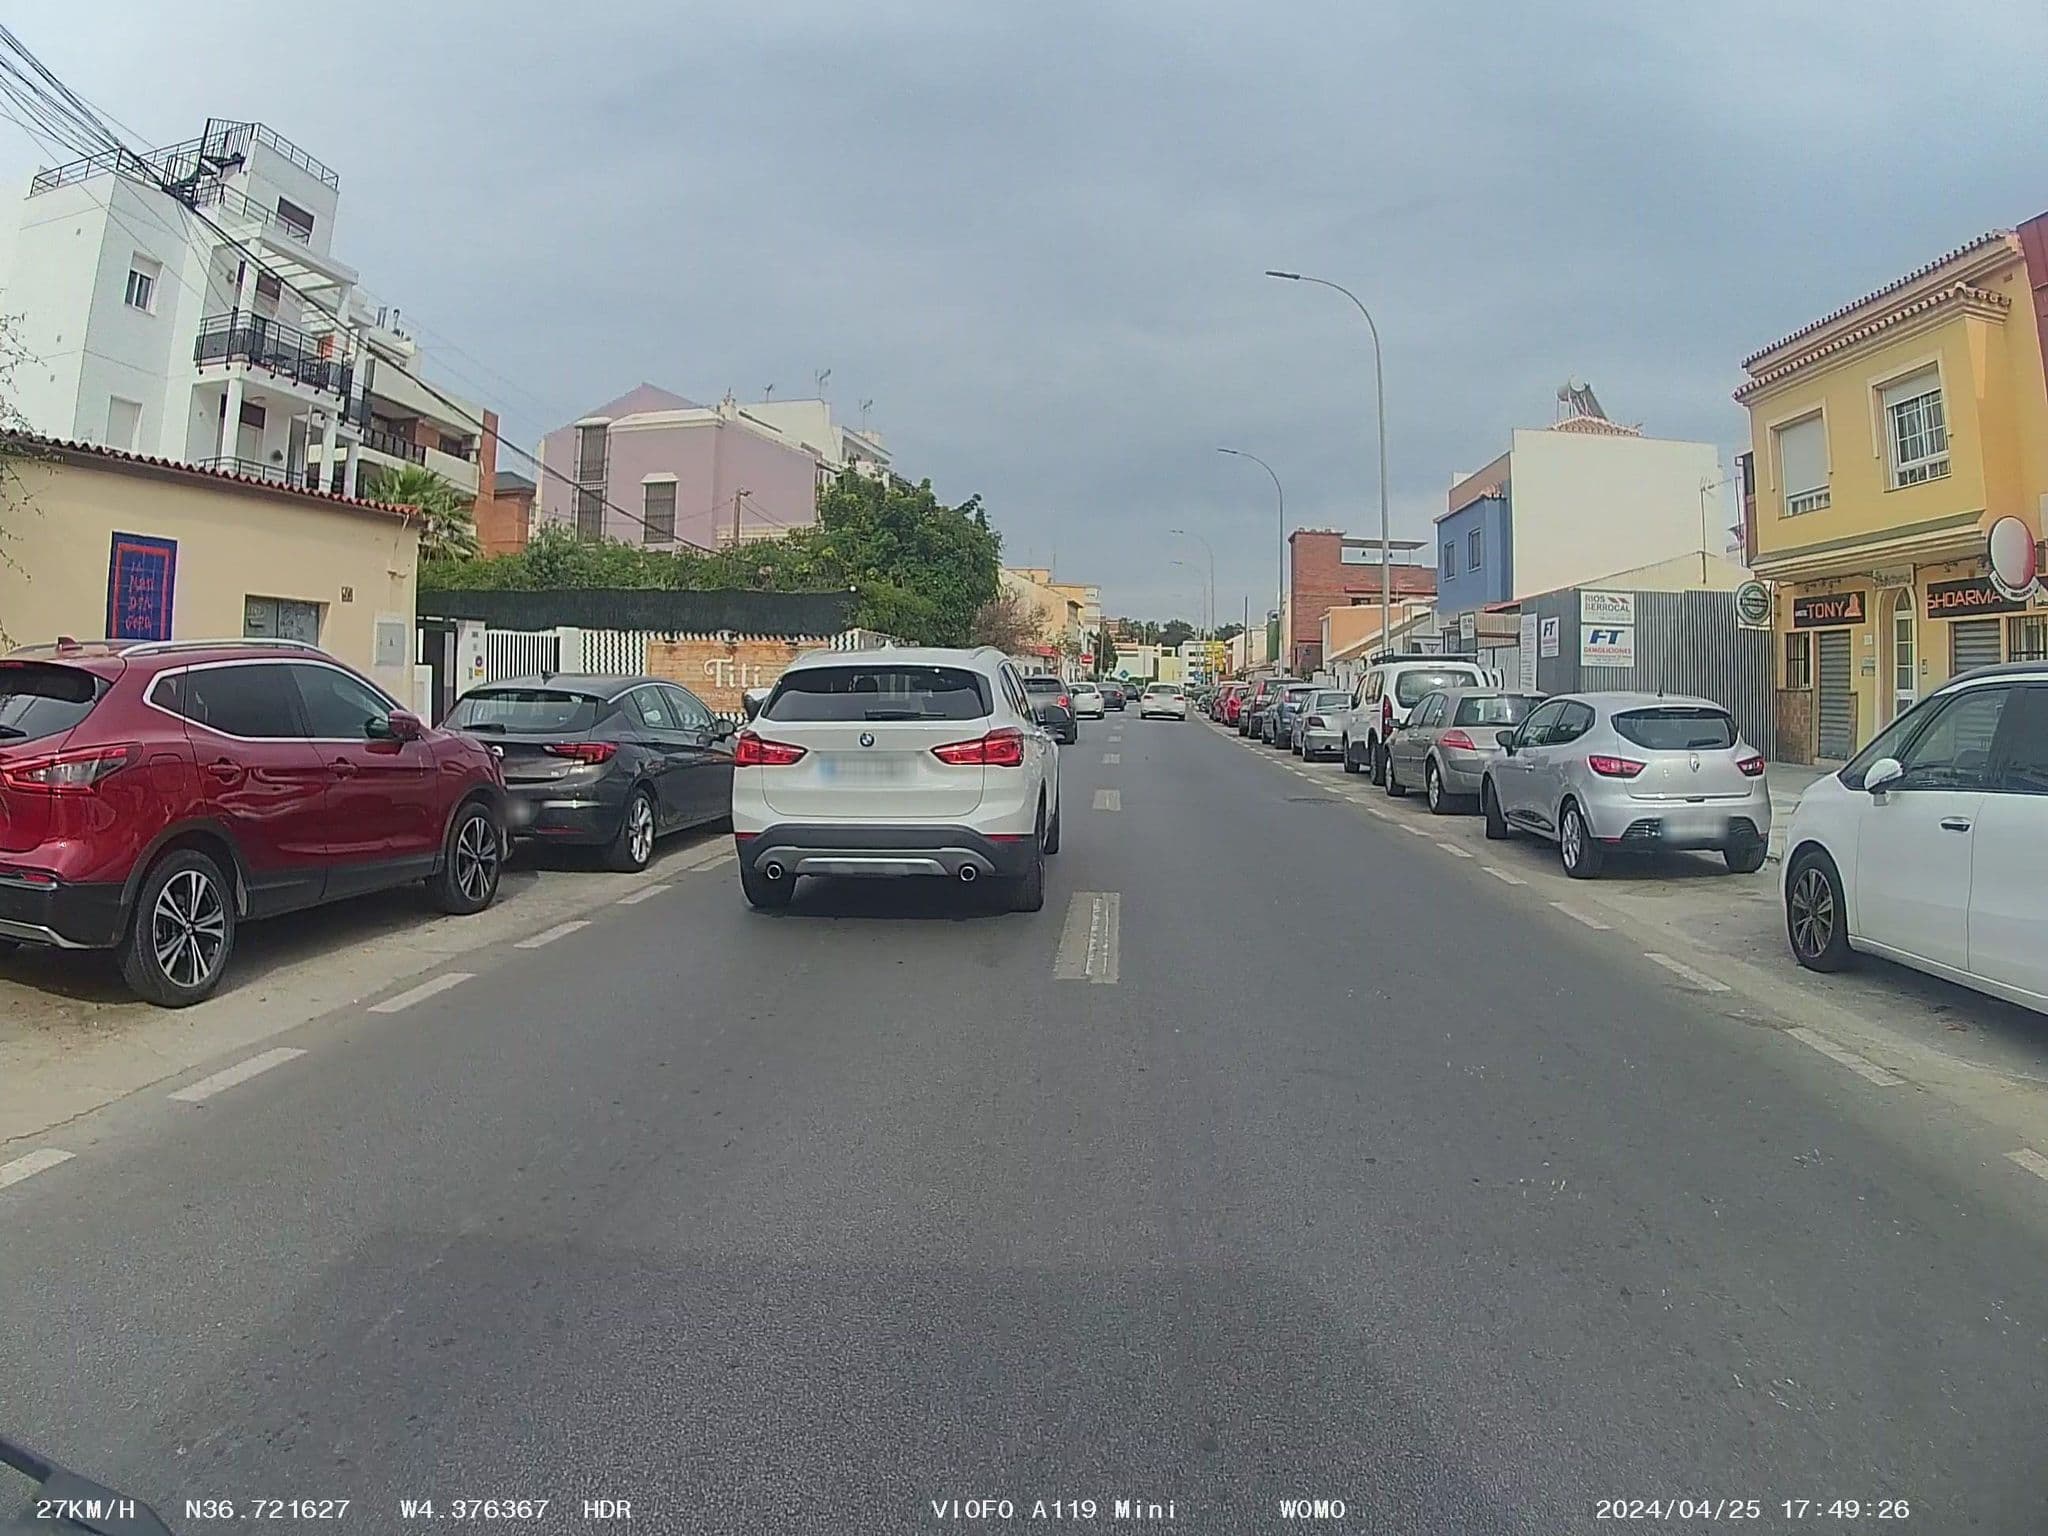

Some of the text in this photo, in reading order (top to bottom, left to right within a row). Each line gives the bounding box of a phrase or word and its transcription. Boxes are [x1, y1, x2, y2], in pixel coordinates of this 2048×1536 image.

[1927, 588, 2002, 610] SHOARMA
[1806, 601, 1845, 619] TONY
[1543, 621, 1555, 637] FT
[1589, 629, 1625, 645] FT
[703, 655, 761, 689] Titi
